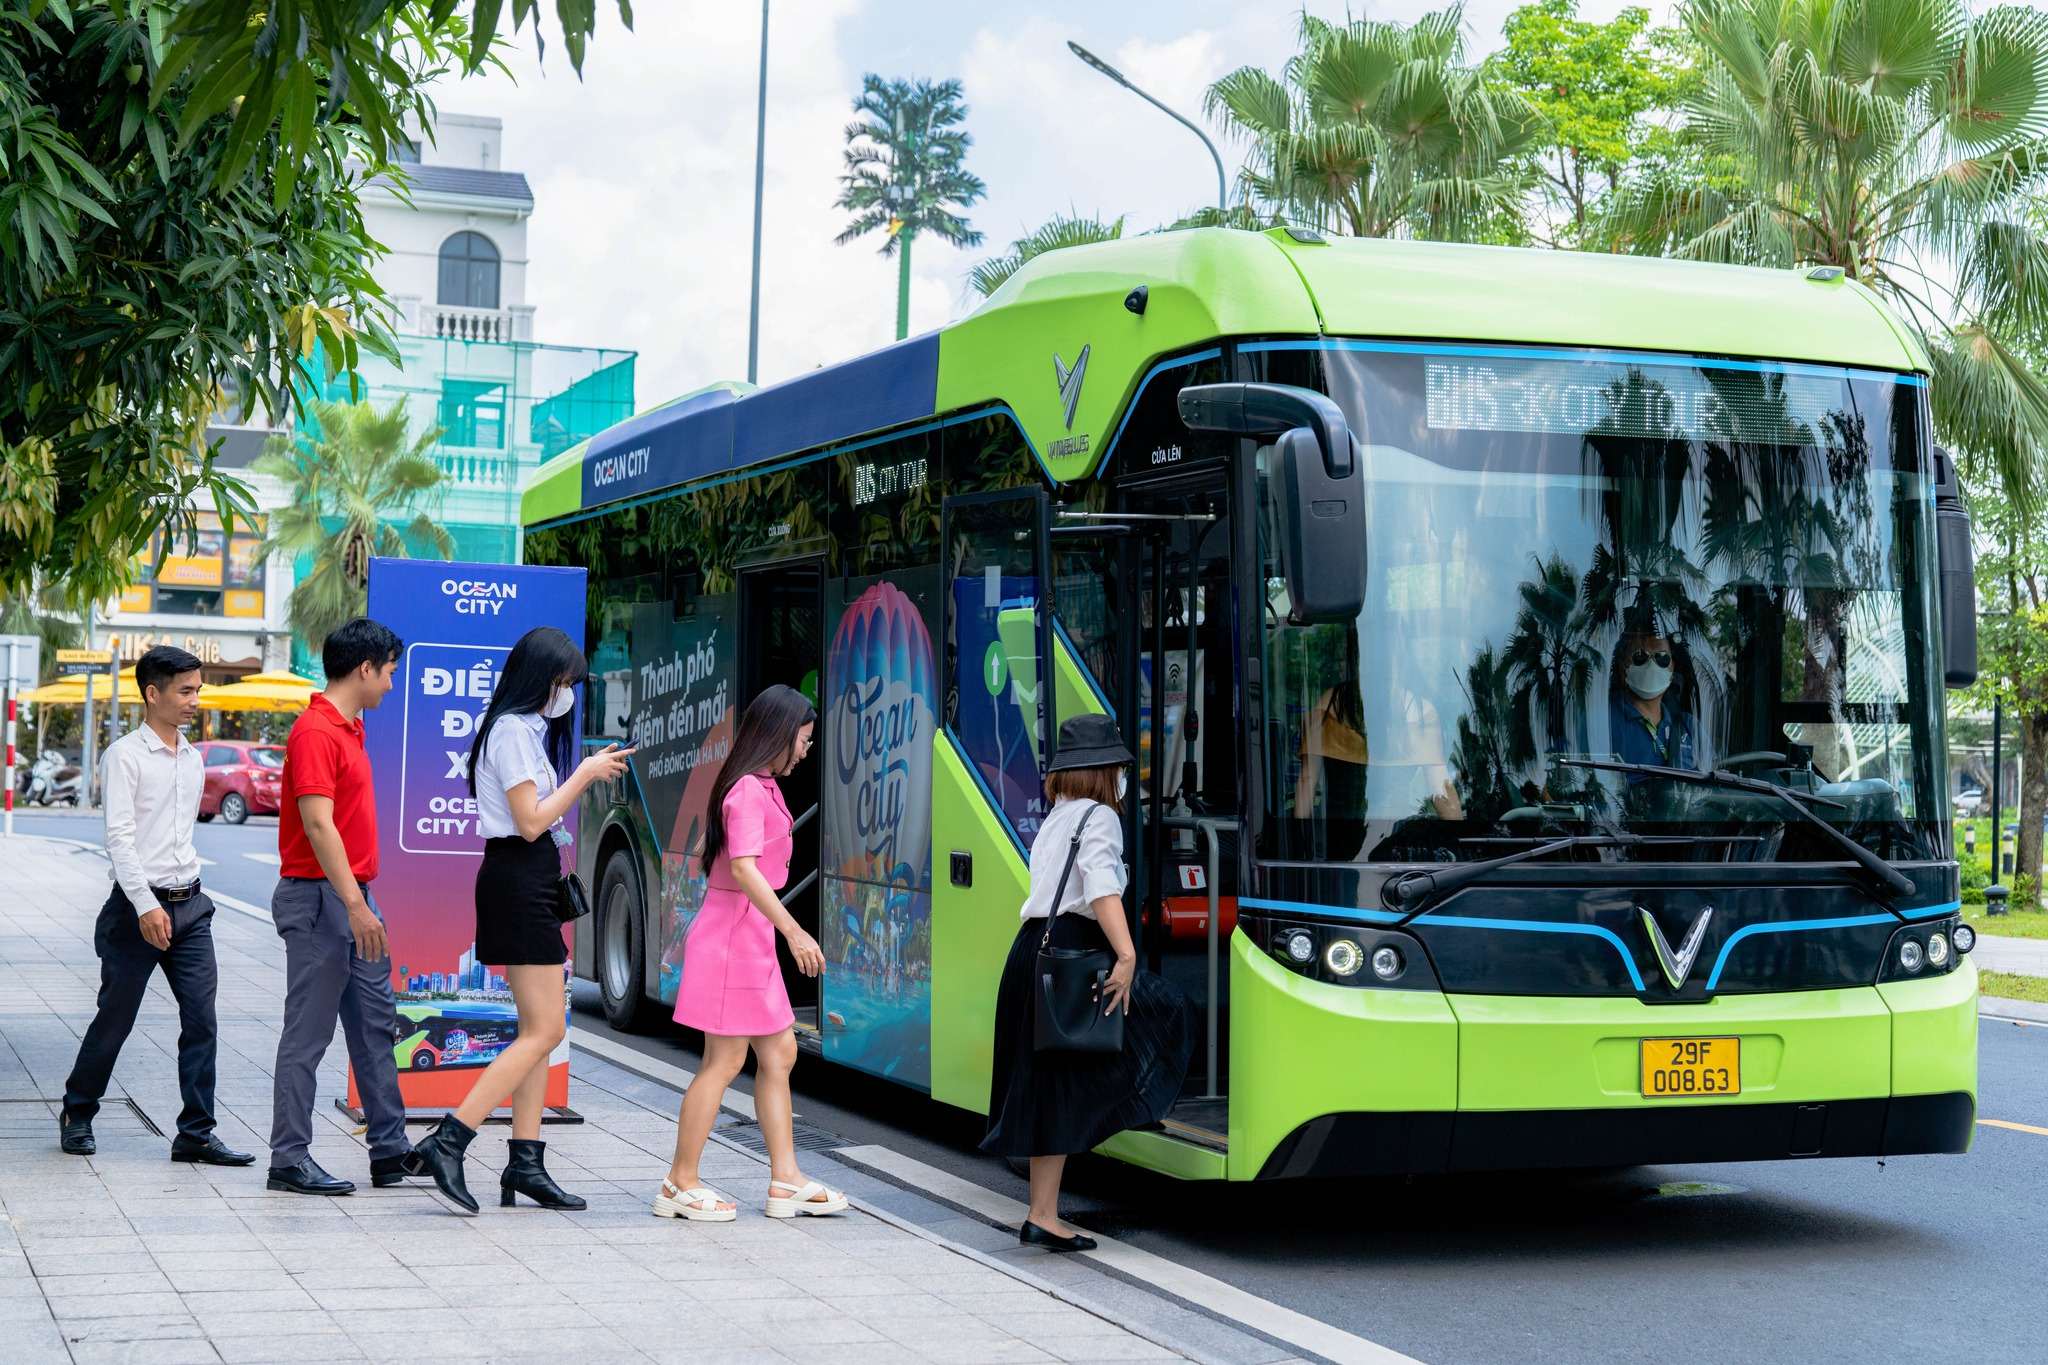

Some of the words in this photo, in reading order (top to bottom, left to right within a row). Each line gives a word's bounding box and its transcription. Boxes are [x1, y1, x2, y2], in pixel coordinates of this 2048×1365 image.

[1427, 364, 1498, 430] BUS
[1562, 385, 1629, 428] CITY
[1640, 389, 1723, 434] TOUR
[594, 454, 627, 488] OCEAN
[627, 446, 651, 478] CITY
[1151, 446, 1167, 465] CỬA
[1167, 444, 1182, 463] LÊN
[855, 463, 876, 504] BUS
[879, 464, 900, 495] CITY
[901, 458, 928, 489] TOUR
[441, 579, 516, 598] OCEAN
[455, 598, 504, 616] CITY
[640, 650, 683, 702] Thành
[686, 628, 718, 694] phố
[667, 694, 694, 741] đến
[697, 679, 728, 732] mới
[837, 674, 918, 785] Ocean
[664, 750, 685, 776] ĐÔNG
[685, 742, 701, 767] CỦA
[429, 796, 480, 815] OCE
[416, 817, 469, 835] CITY
[1671, 1041, 1712, 1065] 29F
[1654, 1068, 1729, 1093] 008.63
